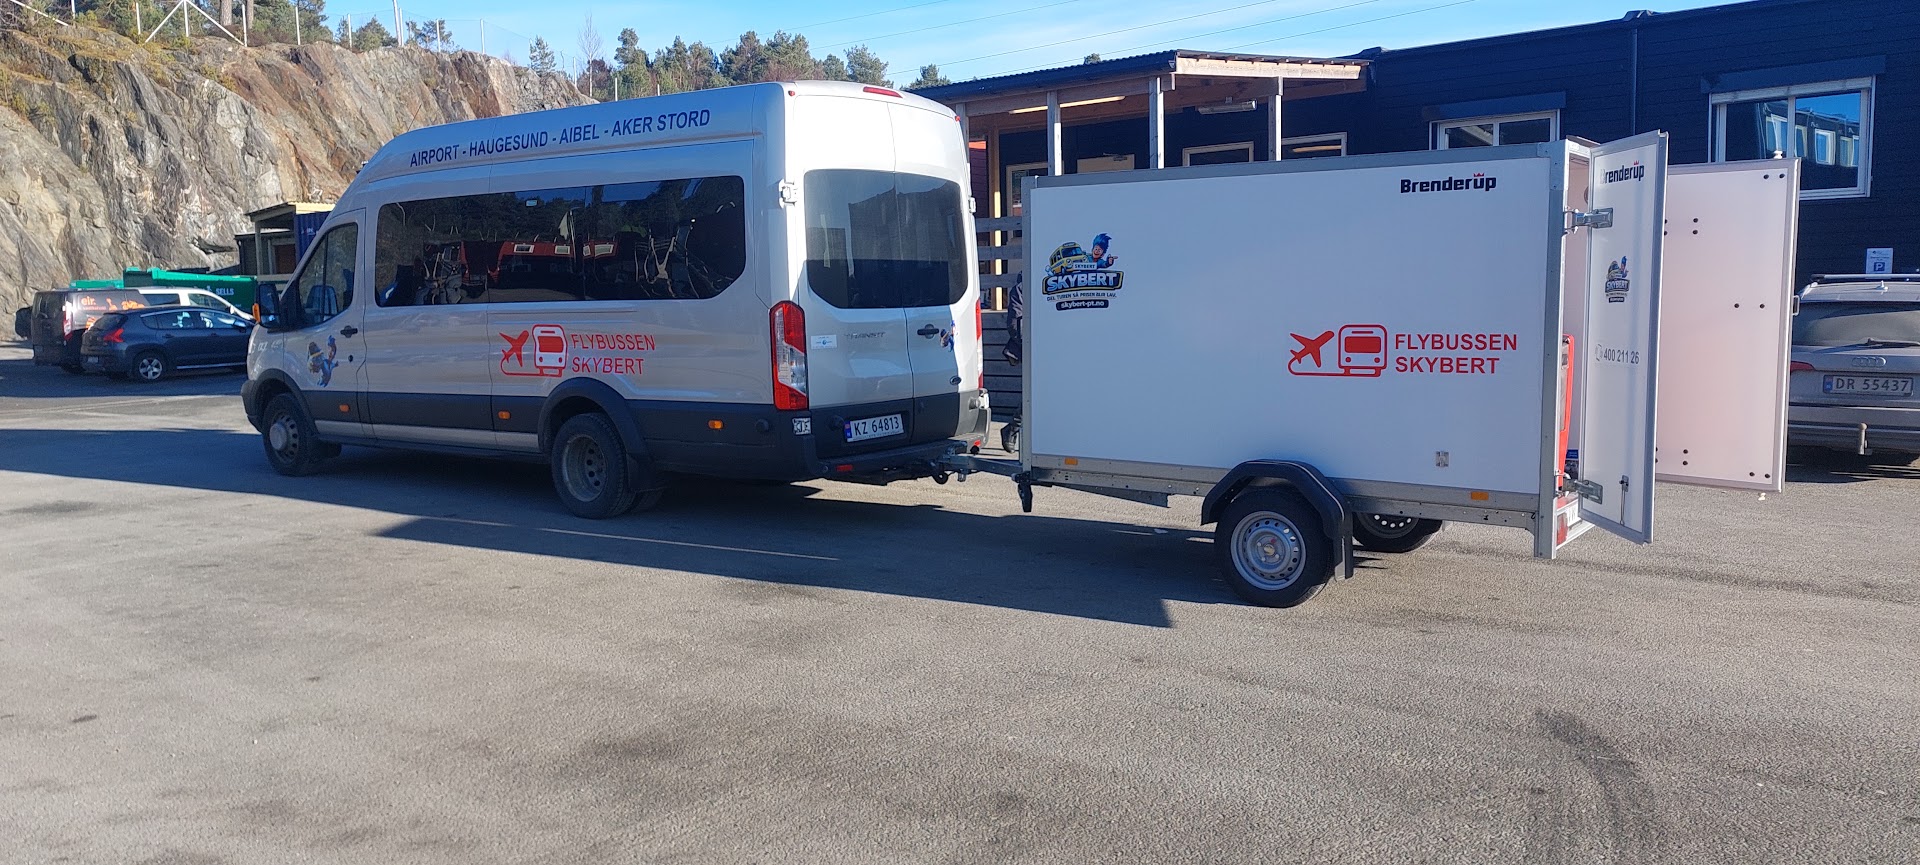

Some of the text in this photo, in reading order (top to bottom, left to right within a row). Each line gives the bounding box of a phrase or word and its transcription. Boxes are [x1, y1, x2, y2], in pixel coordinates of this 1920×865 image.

[410, 144, 460, 168] AIRPORT
[469, 131, 549, 157] HAUGESUND
[559, 123, 600, 145] AIBEL
[611, 116, 652, 137] AKER
[656, 109, 711, 132] STORD
[1047, 272, 1118, 292] SKYBERT
[215, 287, 235, 296] SELLS
[1060, 300, 1105, 309] skybert-pt.no
[571, 333, 656, 351] FLYBUSSEN
[1395, 333, 1518, 351] FLYBUSSEN
[571, 356, 645, 375] SKYBERT
[1395, 356, 1500, 374] SKYBERT
[1603, 348, 1640, 365] 400 211 26
[1835, 377, 1909, 392] DR 55437
[853, 416, 900, 437] KZ 64813
